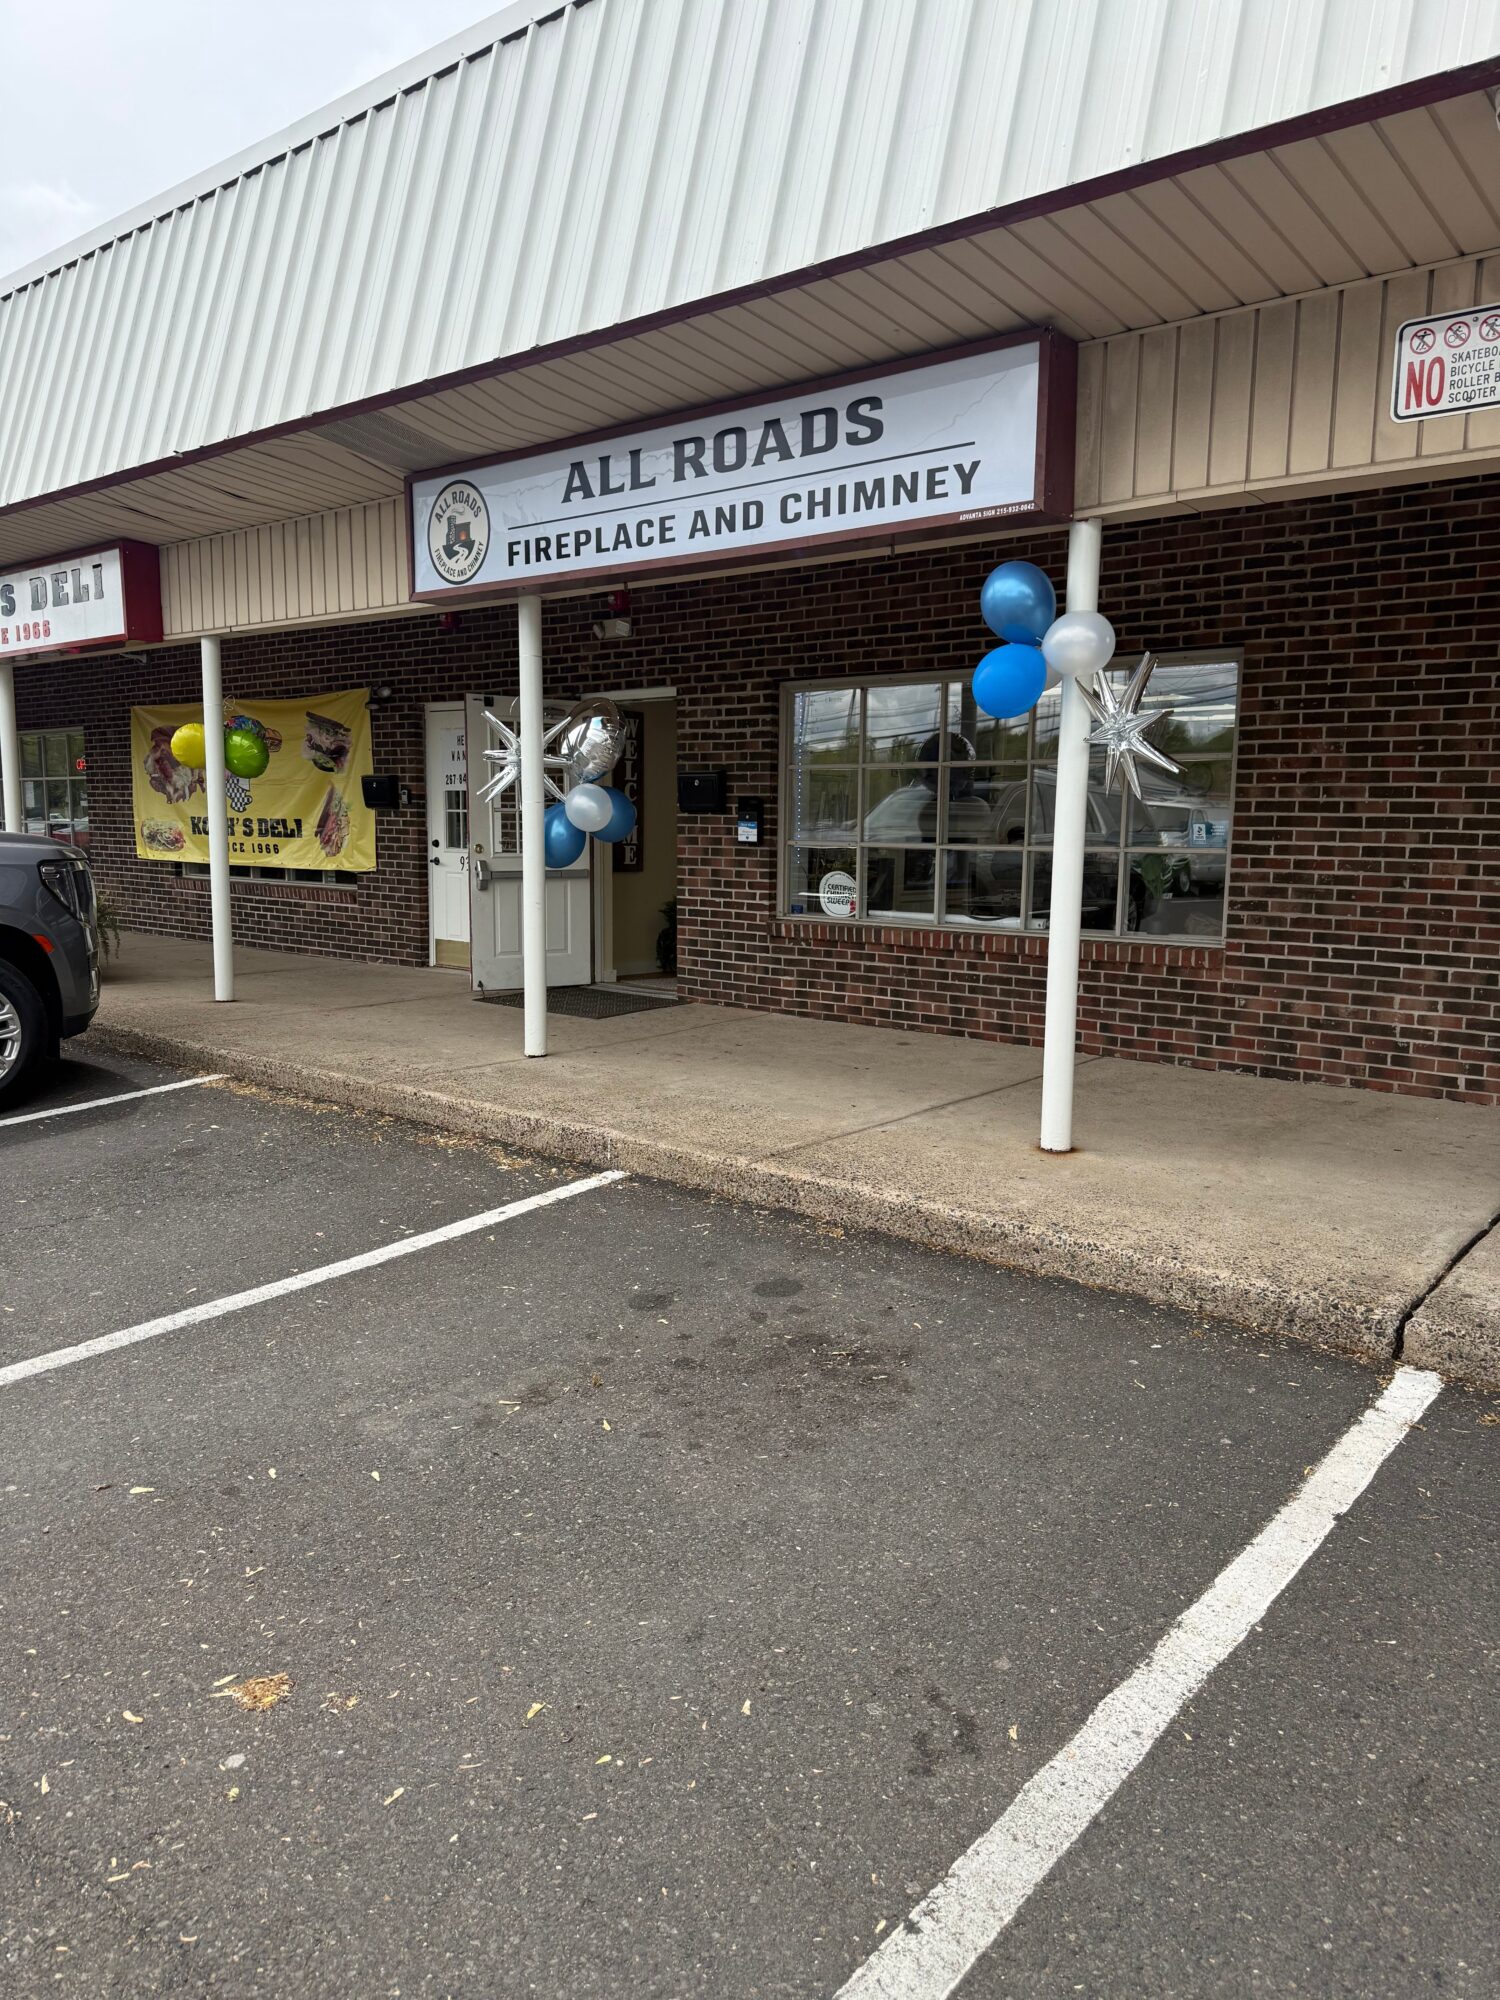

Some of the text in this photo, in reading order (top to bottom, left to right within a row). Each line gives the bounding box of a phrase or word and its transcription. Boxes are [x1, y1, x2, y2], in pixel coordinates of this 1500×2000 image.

[1451, 346, 1500, 364] SKATEBO
[1450, 360, 1495, 377] BICYCLE
[1405, 356, 1445, 410] NO
[1449, 374, 1490, 390] ROLLER
[1448, 386, 1496, 403] SCOOTER
[561, 396, 884, 504] ALL ROADS
[434, 490, 482, 524] ALL ROADS
[508, 460, 981, 567] FIREPLACE AND CHIMNEY
[960, 511, 982, 521] ADVANTA
[983, 509, 995, 517] SIGN
[434, 541, 484, 578] FIREPLACE AND CHIMNEY
[29, 563, 104, 611] DELI
[16, 620, 51, 642] 1966
[621, 718, 639, 865] WELCME
[190, 816, 303, 838] KOH'S DELI
[252, 843, 280, 854] 1966
[827, 897, 850, 905] SWEEP
